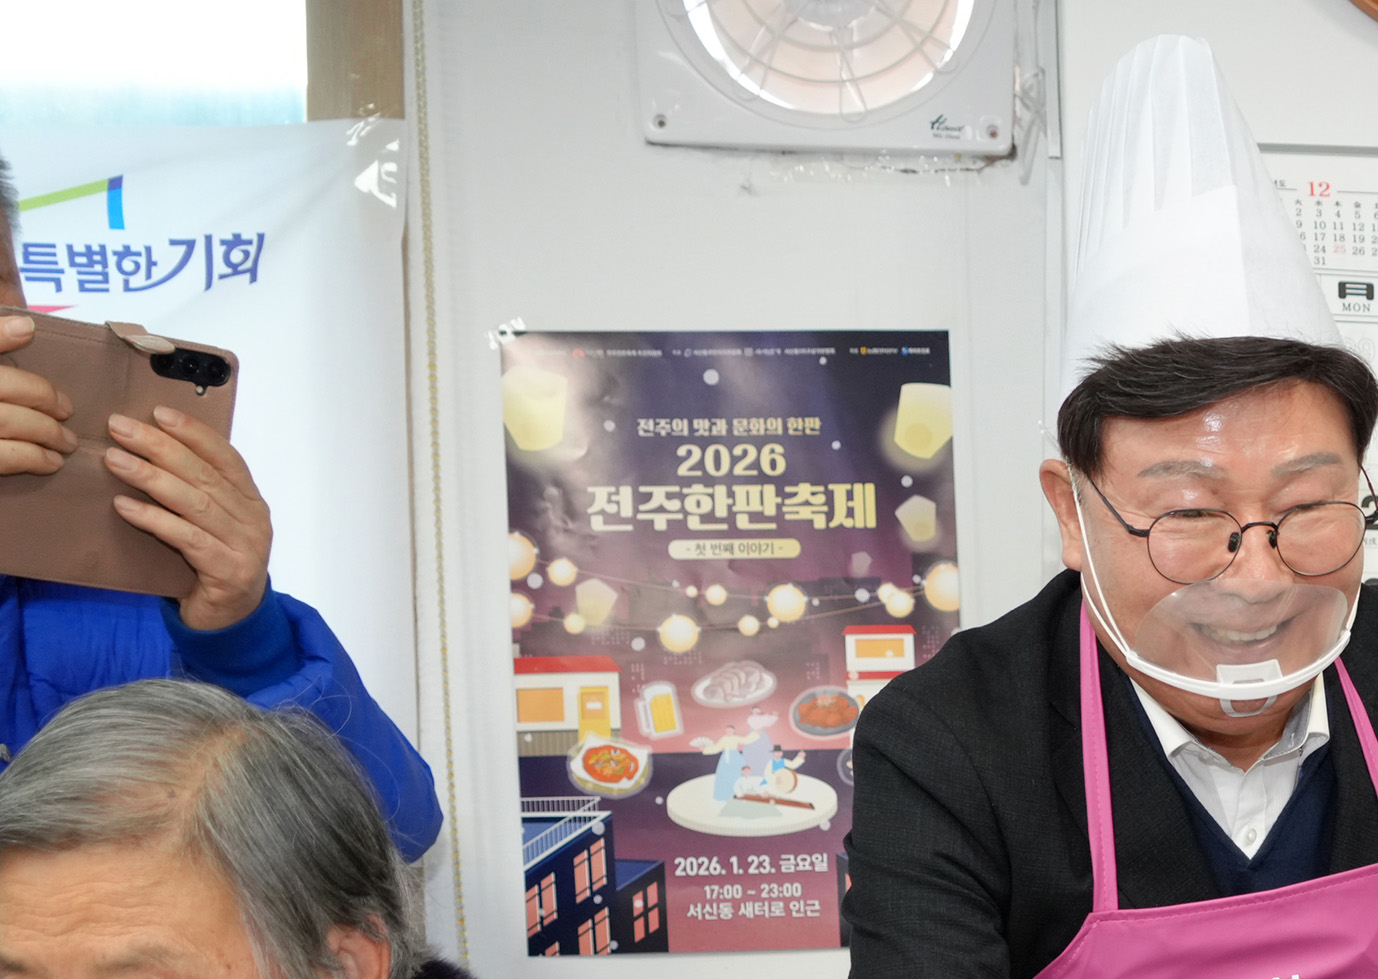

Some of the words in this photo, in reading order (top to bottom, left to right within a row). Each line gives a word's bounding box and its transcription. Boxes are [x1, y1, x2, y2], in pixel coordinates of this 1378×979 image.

[1308, 181, 1331, 197] 12
[1337, 281, 1374, 301] 月
[1342, 302, 1371, 313] MON
[637, 418, 688, 437] 전주의
[693, 418, 727, 437] 맛과
[732, 417, 782, 436] 문화의
[787, 417, 821, 435] 한판
[676, 443, 786, 477] 2026
[586, 482, 877, 532] 전주한판축제
[694, 541, 707, 557] 첫
[710, 541, 735, 557] 번째
[738, 541, 774, 556] 이야기
[674, 857, 727, 877] 2026.
[729, 857, 744, 876] 1.
[748, 855, 776, 875] 23.
[779, 853, 829, 874] 금요일
[704, 883, 743, 900] 17:00
[760, 883, 802, 899] 23:00
[687, 902, 735, 920] 서신동
[738, 901, 786, 919] 새터로
[789, 901, 821, 918] 인근
